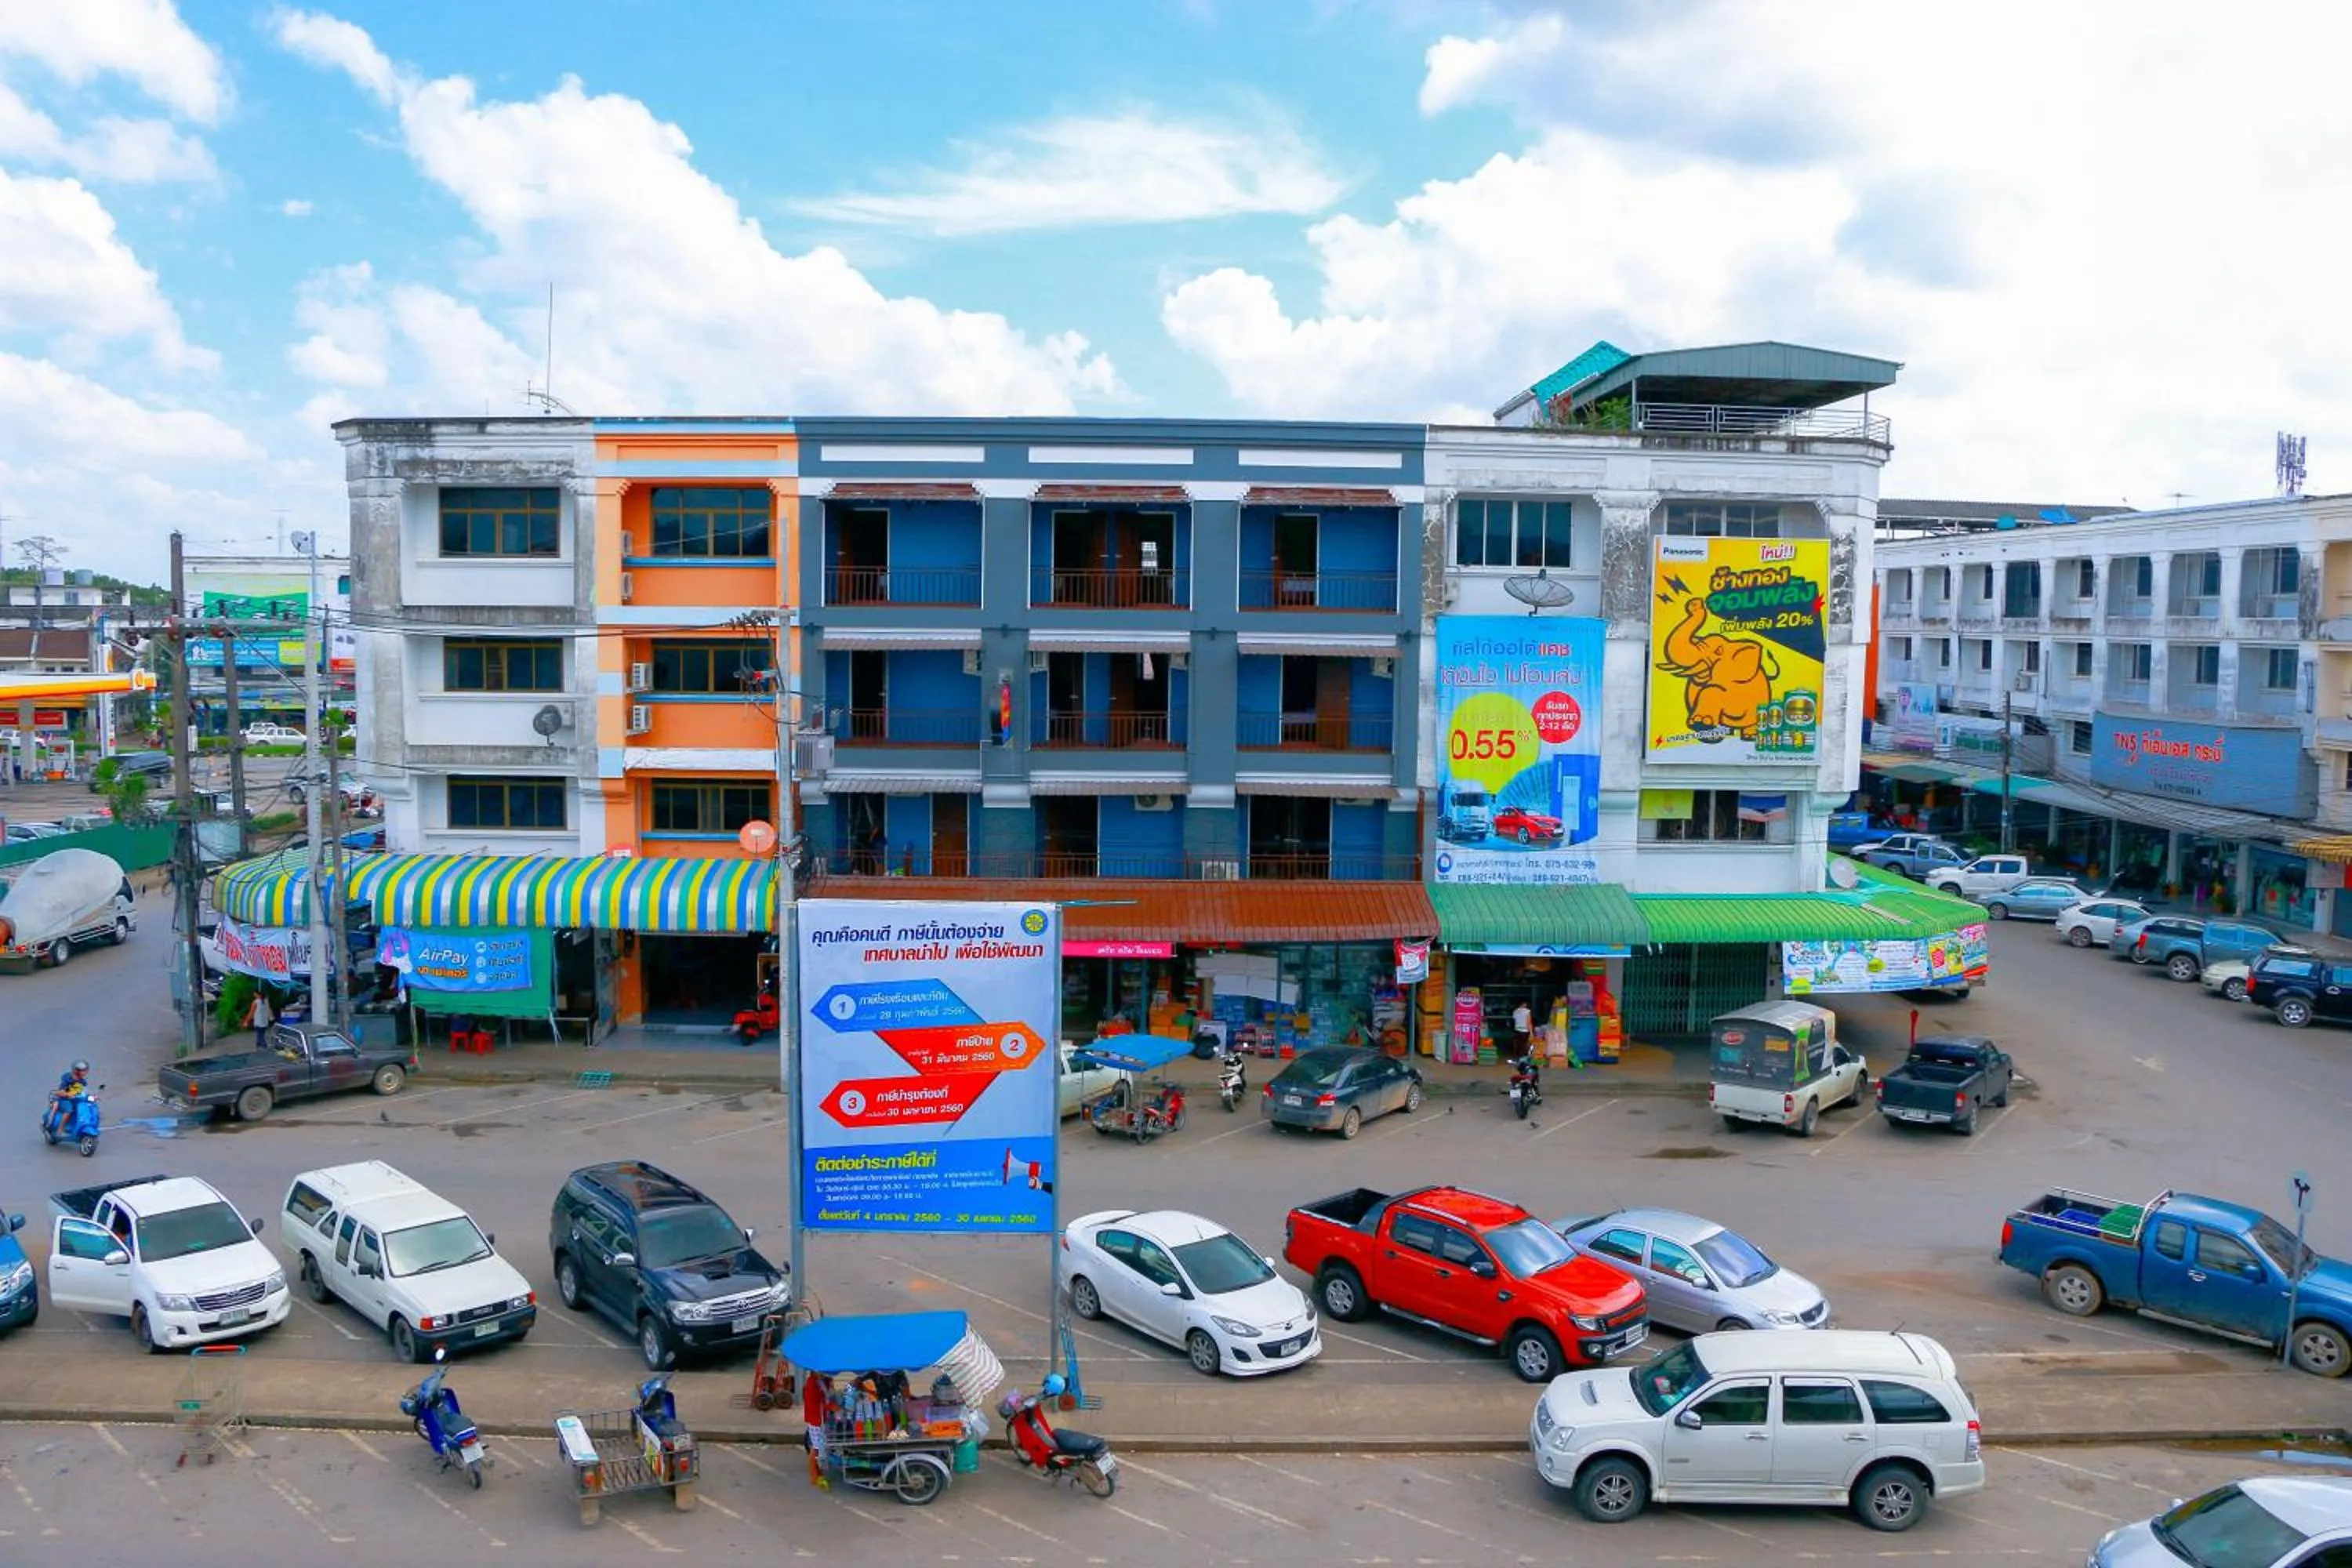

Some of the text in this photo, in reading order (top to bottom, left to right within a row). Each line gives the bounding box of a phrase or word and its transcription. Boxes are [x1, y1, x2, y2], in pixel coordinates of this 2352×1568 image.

[1710, 566, 1791, 591] ช้างทอง
[1708, 578, 1816, 612] จอมพลัง
[1776, 612, 1813, 628] 20%
[812, 920, 1004, 948] คุณคือคนดี ภาษีนั้นต้องจ่าย
[419, 948, 470, 967] AirPay
[864, 941, 1044, 962] เทศบาลนำไป เพื่อใช้พัฒนา
[839, 1001, 847, 1013] 1
[1009, 1040, 1019, 1051] 2
[847, 1098, 857, 1109] 3
[940, 1103, 964, 1113] 2560
[815, 1149, 938, 1172] ติดต่อชำระภาษีได้ที่
